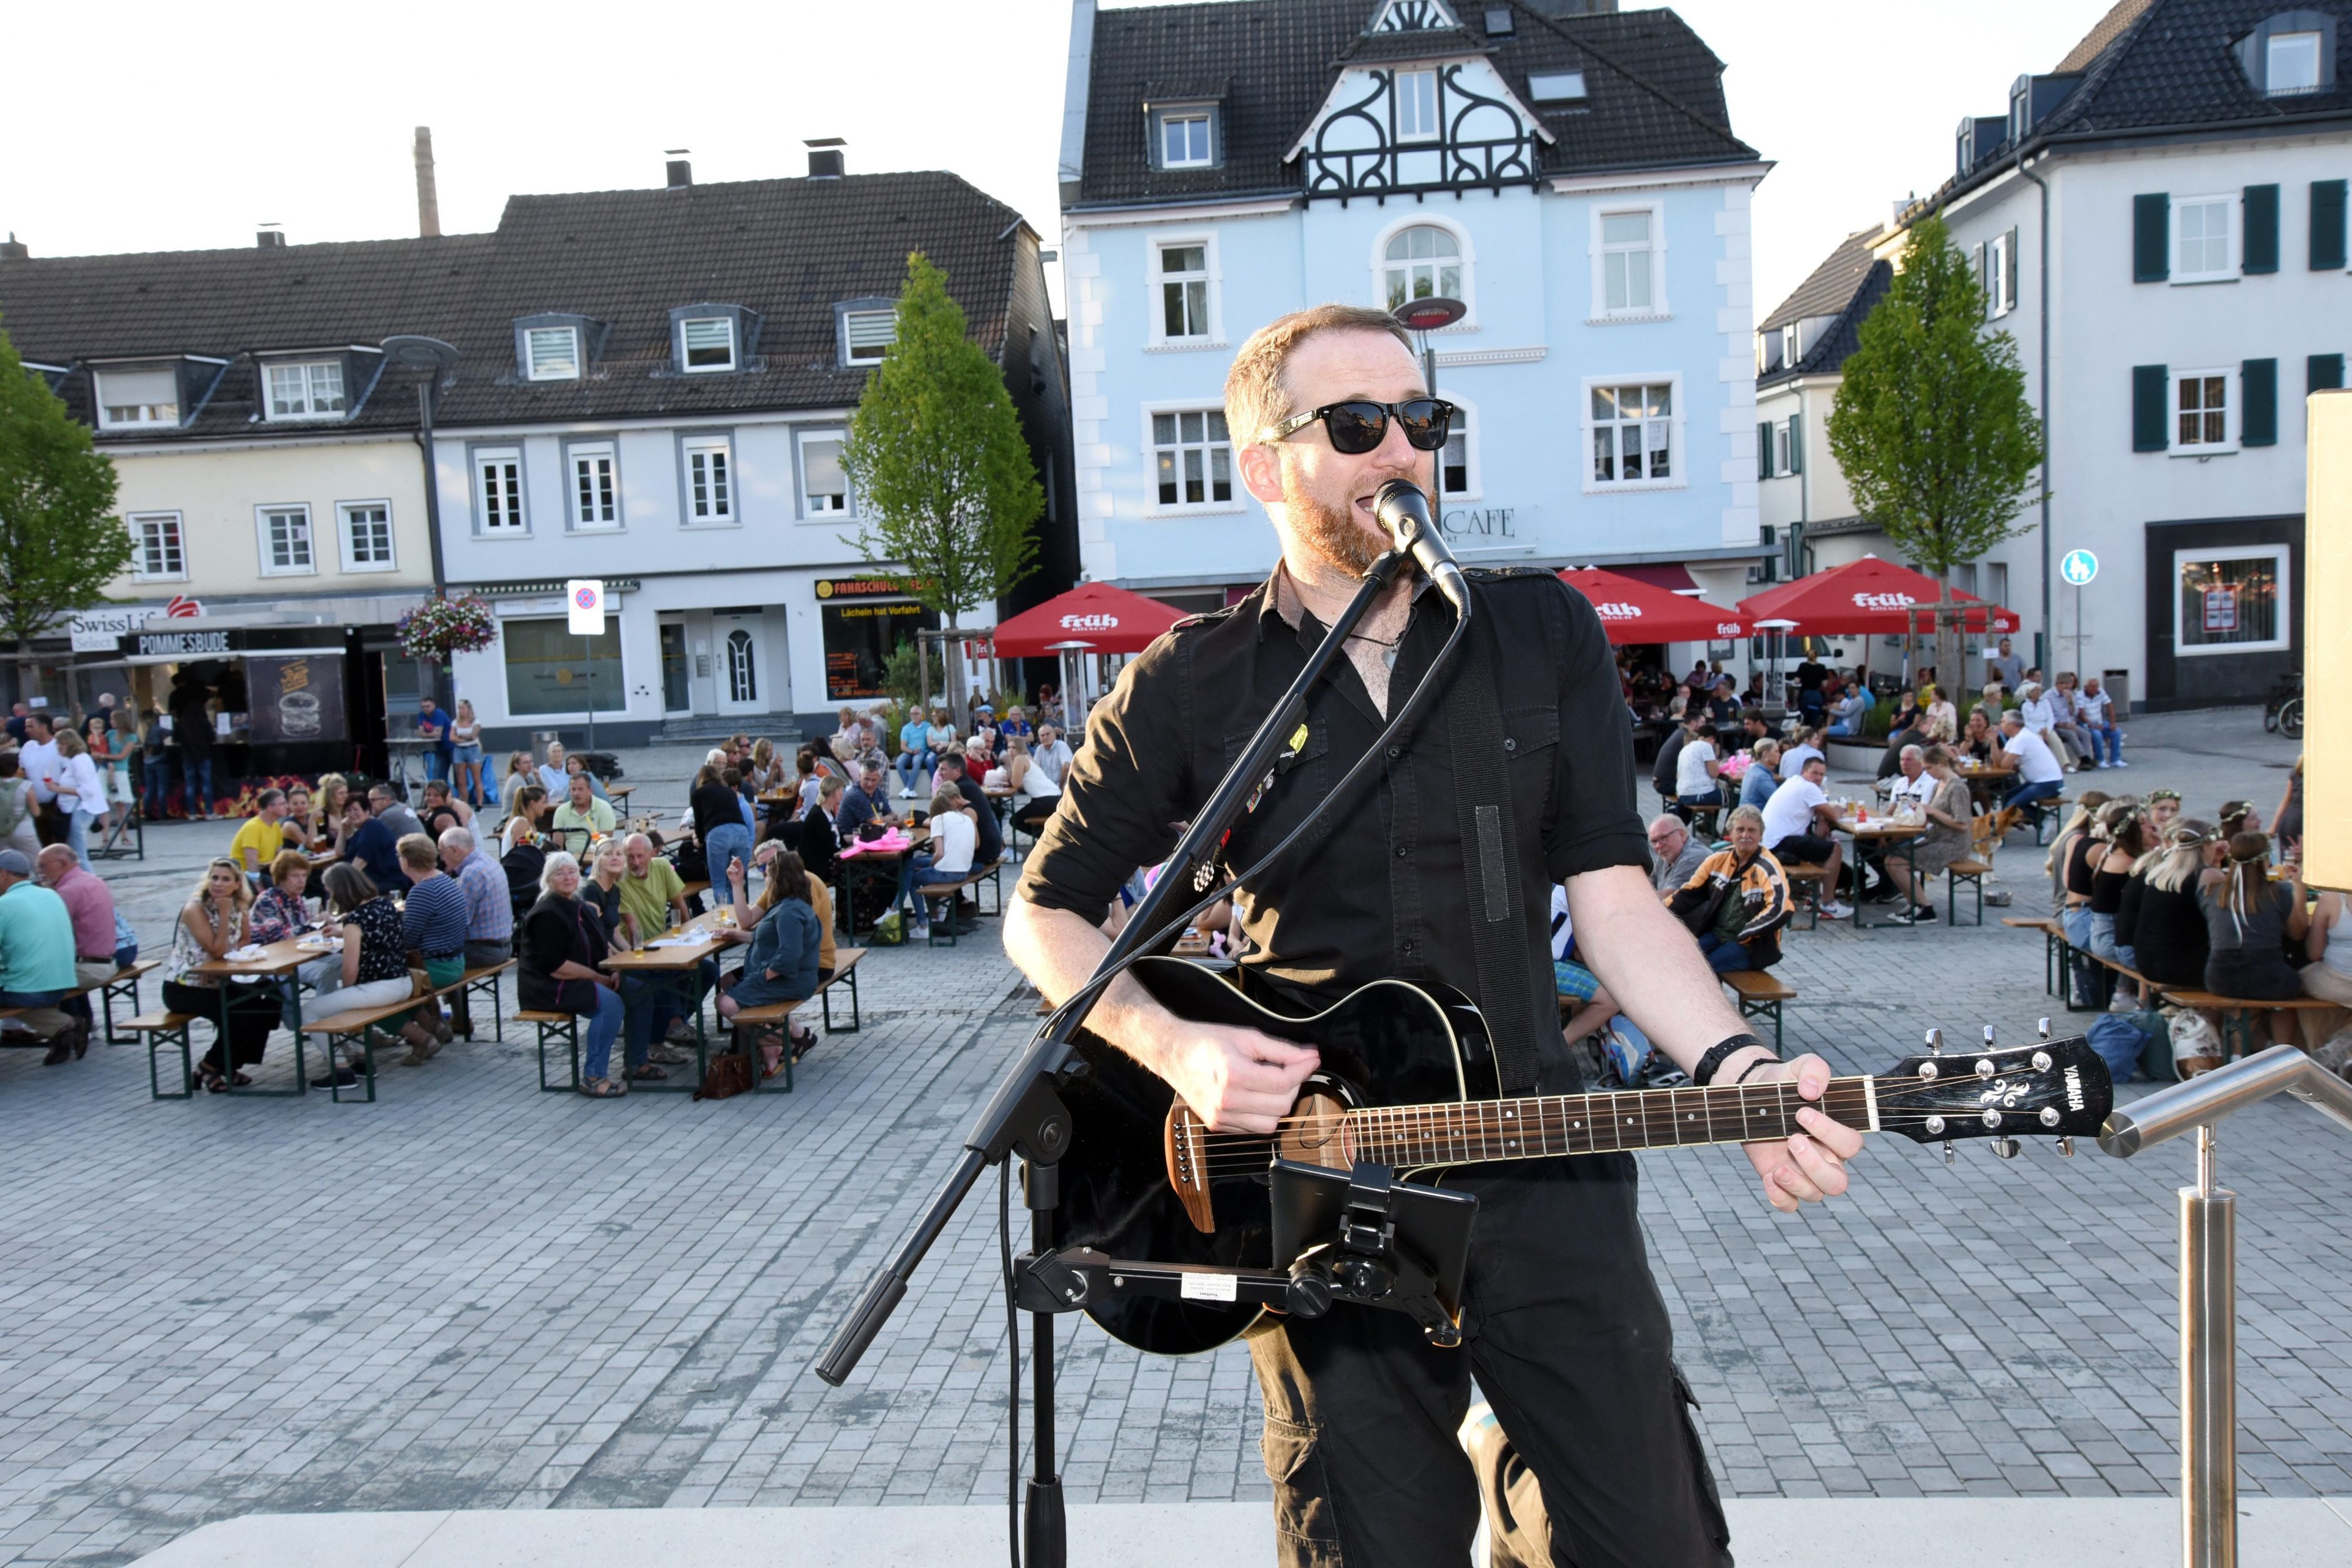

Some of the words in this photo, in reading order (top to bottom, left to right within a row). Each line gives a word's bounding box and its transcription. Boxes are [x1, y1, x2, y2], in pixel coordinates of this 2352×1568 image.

[841, 607, 873, 617] Lächeln
[874, 607, 887, 616] hat
[888, 605, 921, 615] Vorfahrt
[139, 631, 229, 654] POMMESBUDE
[2064, 1064, 2084, 1112] YAMAHA
